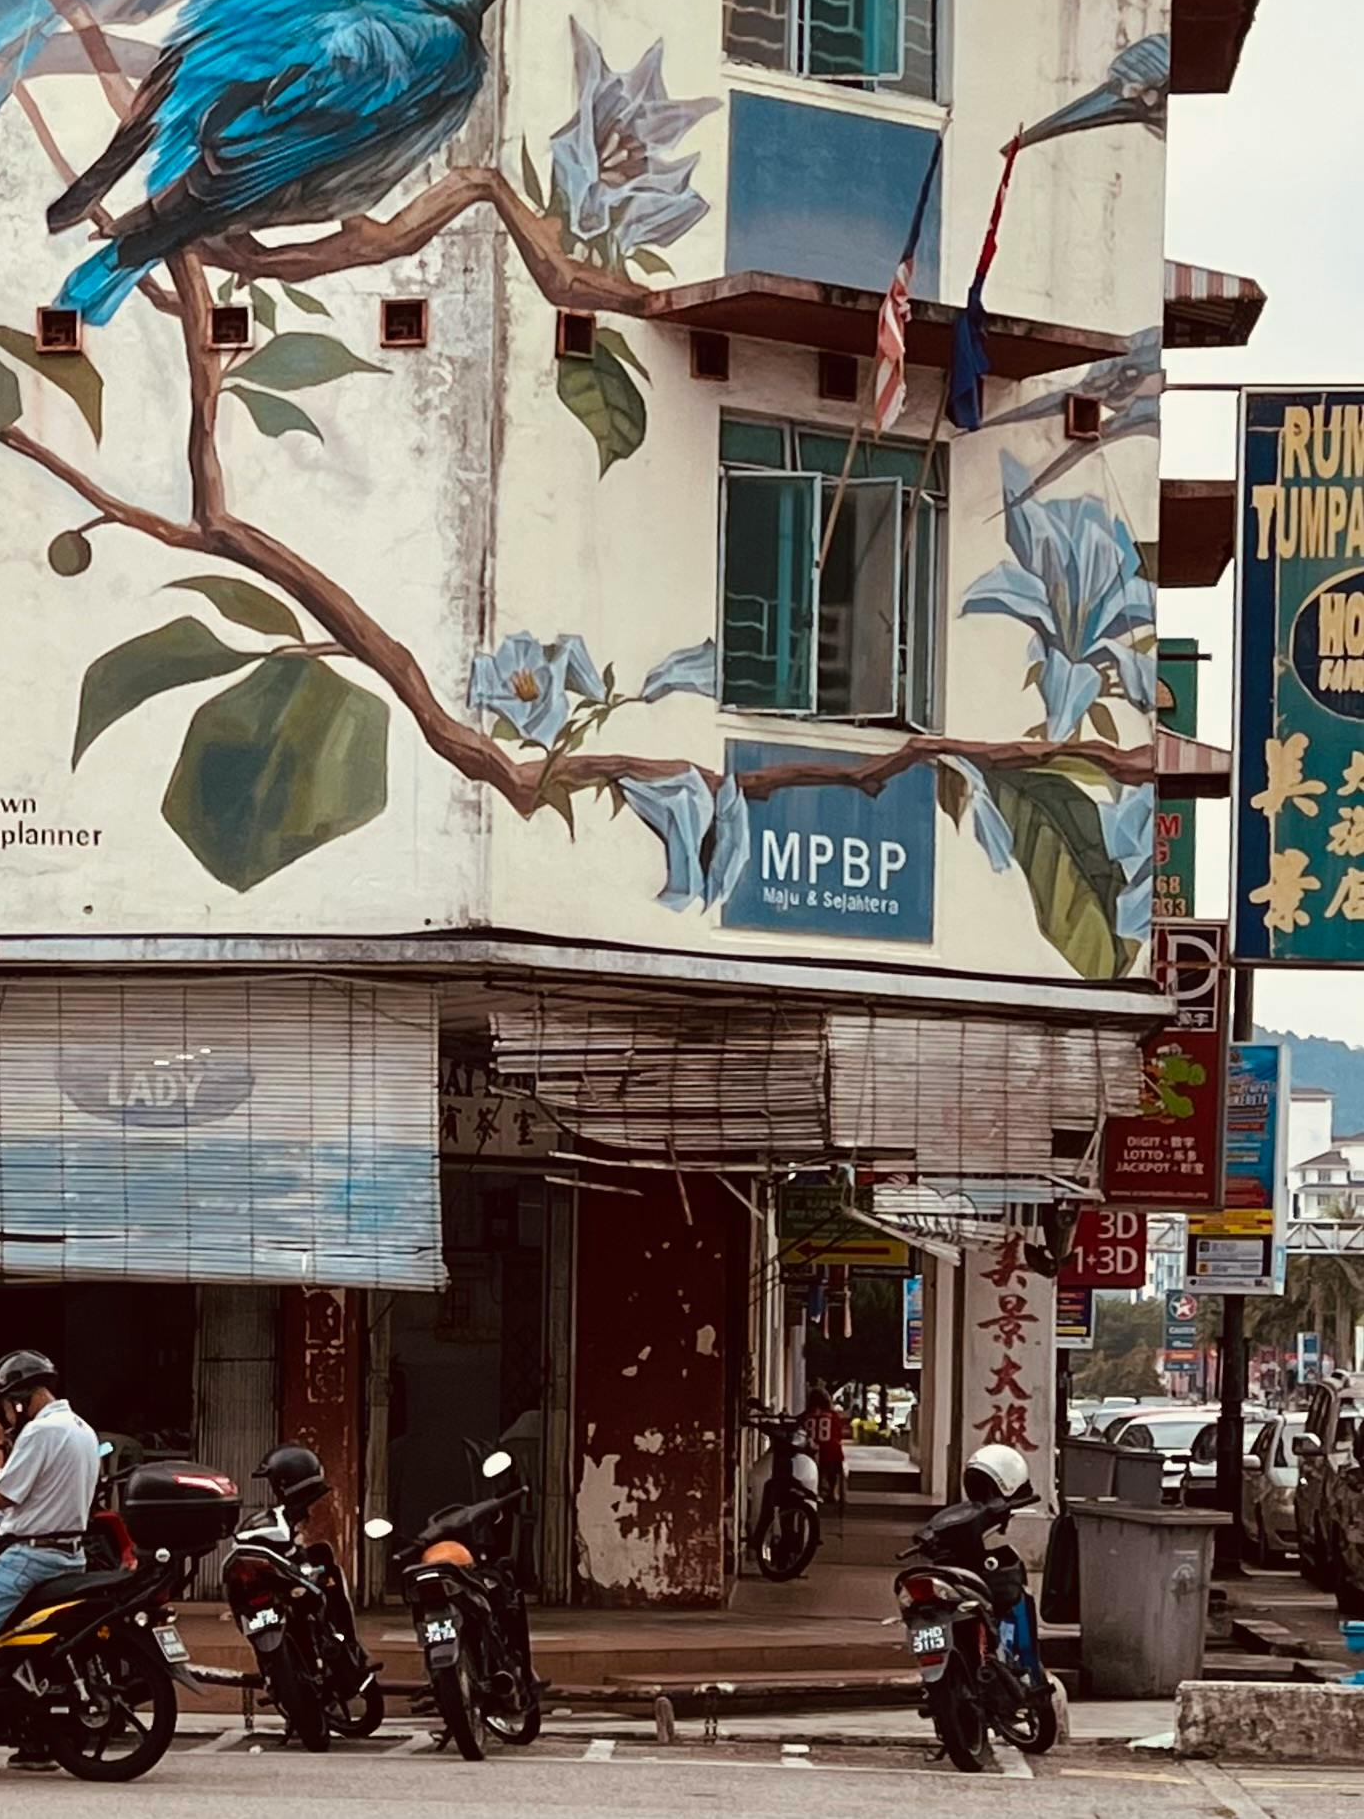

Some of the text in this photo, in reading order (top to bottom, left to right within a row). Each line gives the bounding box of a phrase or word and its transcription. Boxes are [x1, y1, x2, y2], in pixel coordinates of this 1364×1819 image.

[762, 829, 907, 890] MPBP
[806, 889, 818, 907] &
[823, 890, 899, 915] Sejahtera
[108, 1070, 204, 1107] LADY
[1115, 1162, 1171, 1174] JACKPOT
[1123, 1149, 1164, 1161] LOTTO
[1097, 1211, 1138, 1239] 3D
[1073, 1246, 1139, 1275] 1+3D
